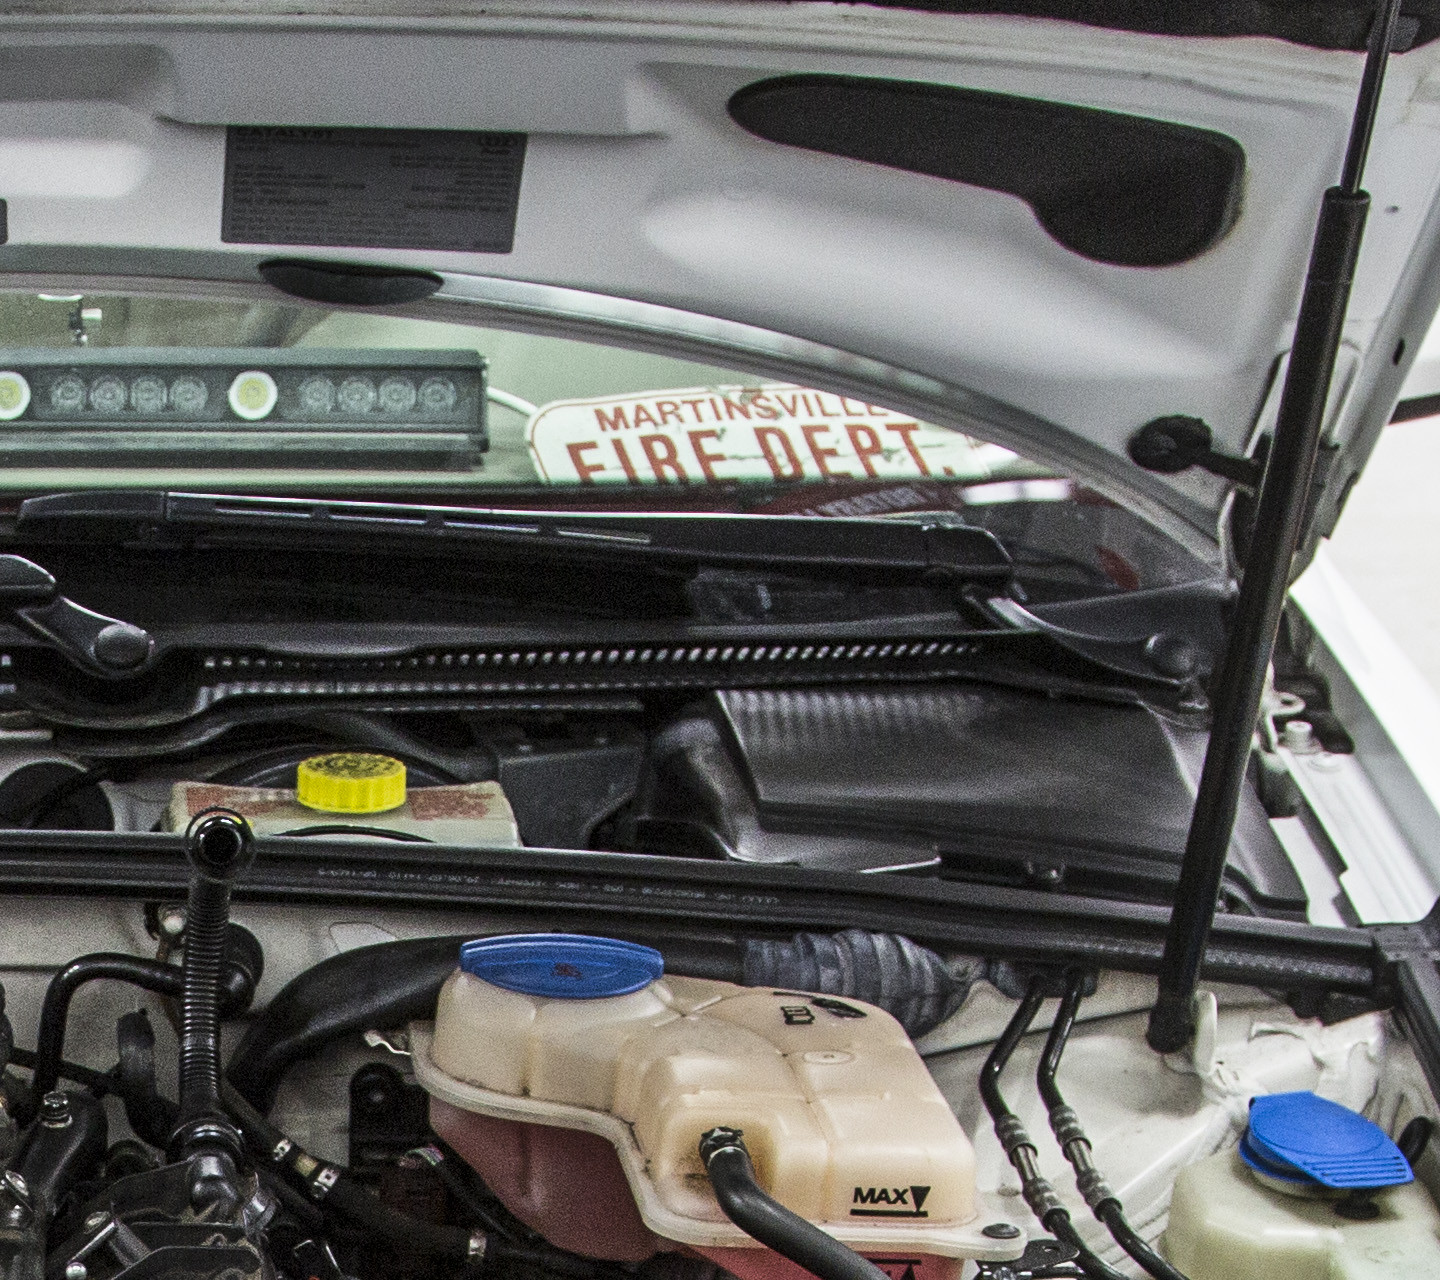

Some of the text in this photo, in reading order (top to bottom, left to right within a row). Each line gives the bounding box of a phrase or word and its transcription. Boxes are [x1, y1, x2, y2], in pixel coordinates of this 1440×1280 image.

[594, 391, 891, 432] MARTINSVILLE
[566, 424, 958, 484] FIRE DEPT.
[853, 1187, 908, 1204] MAX
